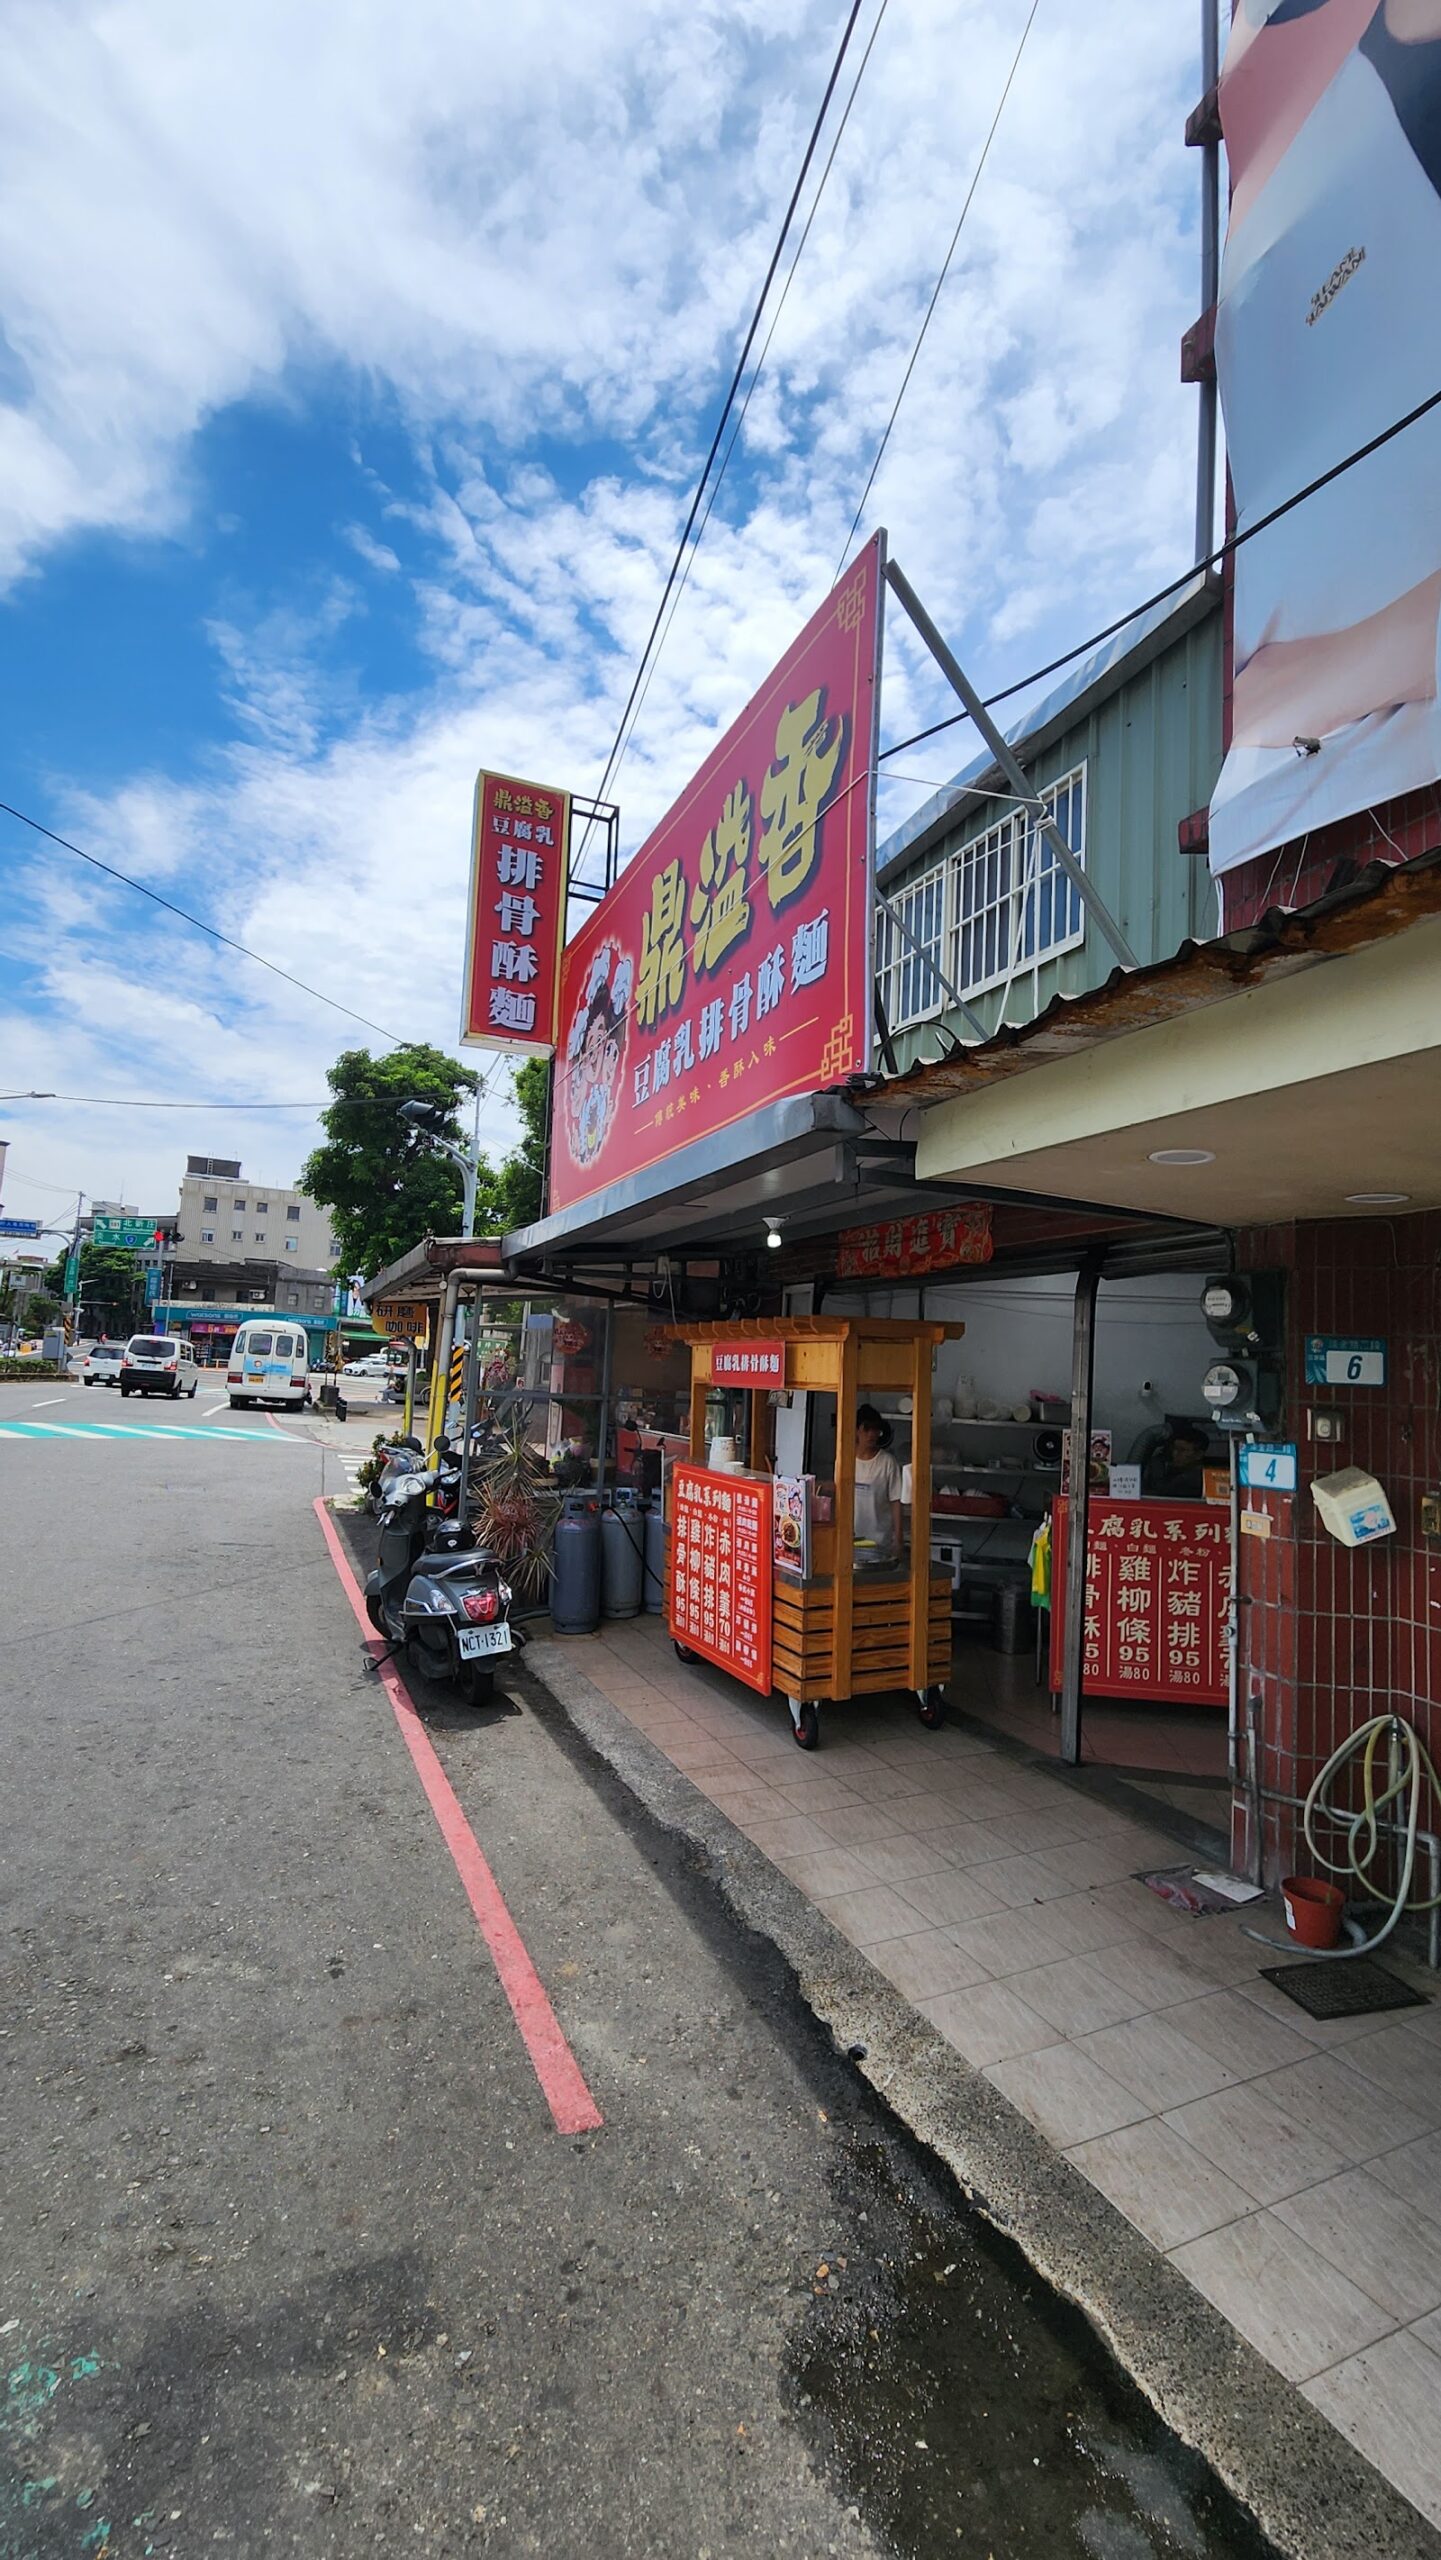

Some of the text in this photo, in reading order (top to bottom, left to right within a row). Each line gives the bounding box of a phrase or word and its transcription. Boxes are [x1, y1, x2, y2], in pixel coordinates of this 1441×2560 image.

[493, 788, 555, 821] 鼎溢香
[491, 814, 555, 846] 豆腐乳
[635, 688, 843, 1026] 鼎溢香
[488, 843, 544, 1032] 排骨酥麵
[632, 908, 830, 1109] 豆腐乳排骨酥麵
[385, 1320, 425, 1334] 咖啡
[715, 1353, 780, 1373] 豆腐乳排骨酥麵
[1347, 1355, 1363, 1380] 6
[1265, 1459, 1277, 1482] 4
[677, 1479, 732, 1513] 豆腐乳系列麵
[1088, 1514, 1232, 1544] 腐乳系列
[676, 1513, 688, 1595] 排骨酥
[690, 1518, 701, 1603] 雞柳條
[704, 1523, 716, 1610] 炸豬排
[676, 1596, 686, 1612] 95
[690, 1603, 700, 1620] 95
[1117, 1555, 1152, 1644] 雞柳條
[1167, 1558, 1202, 1649] 炸豬排
[704, 1610, 714, 1628] 95
[719, 1618, 731, 1637] 70
[1085, 1642, 1100, 1659] 5
[1118, 1645, 1150, 1663] 95
[1169, 1649, 1200, 1667] 95
[1083, 1663, 1100, 1677] 80
[1119, 1665, 1150, 1681] 湯80
[1169, 1669, 1200, 1685] 湯80
